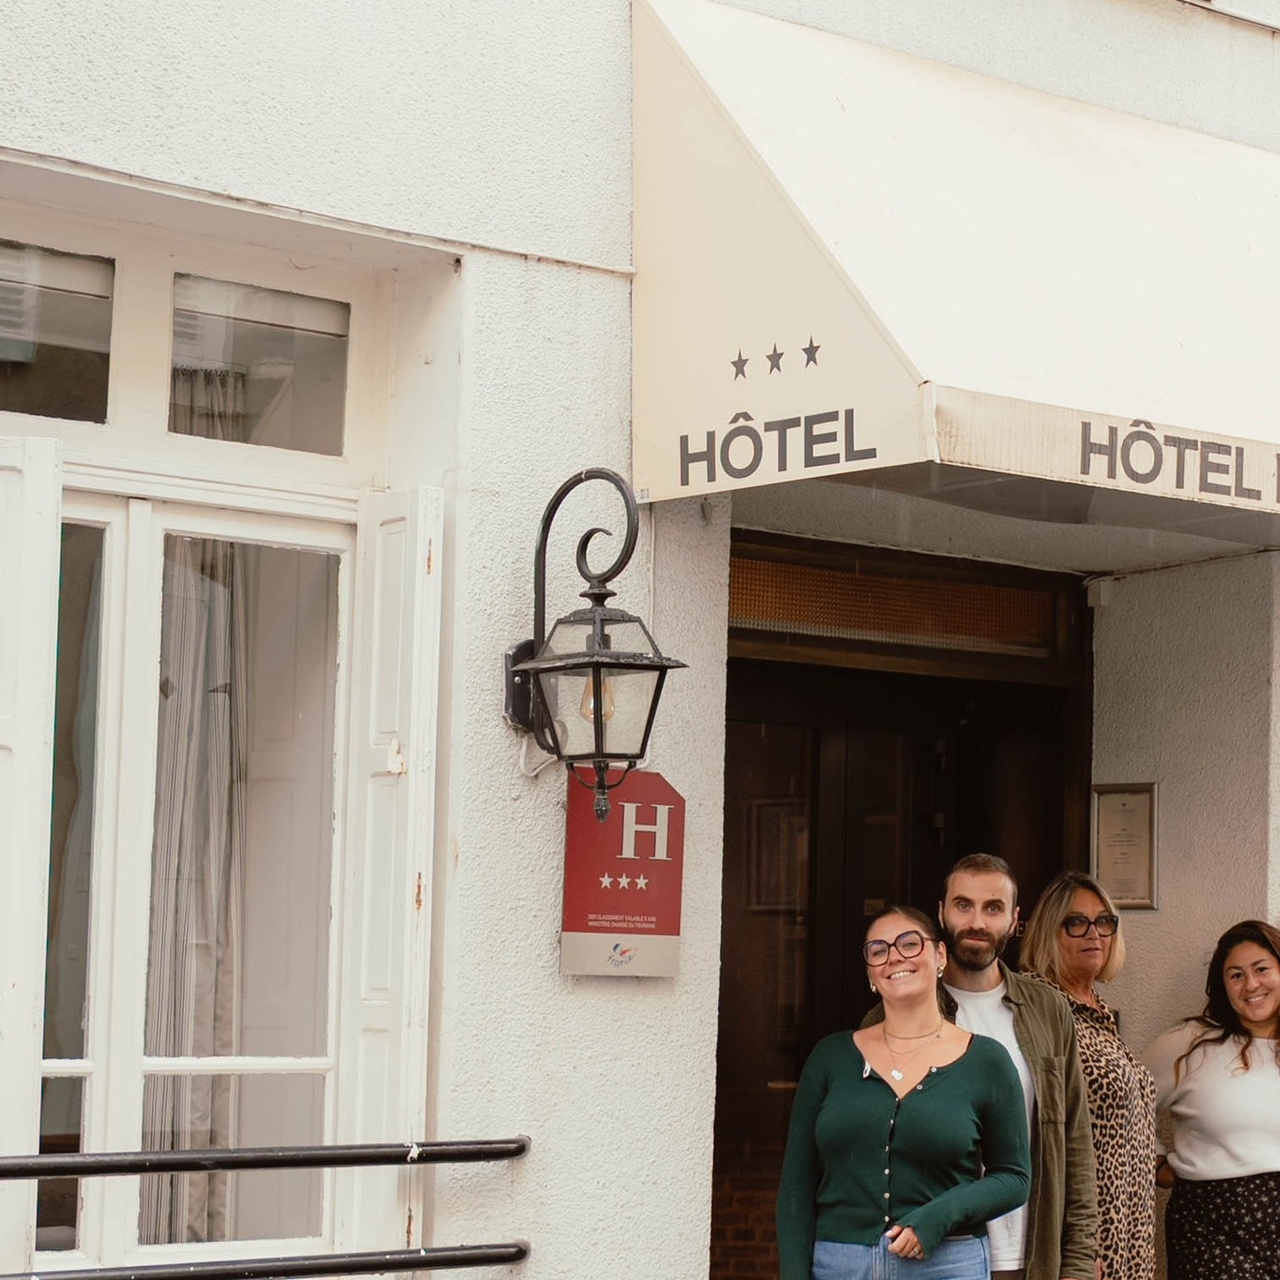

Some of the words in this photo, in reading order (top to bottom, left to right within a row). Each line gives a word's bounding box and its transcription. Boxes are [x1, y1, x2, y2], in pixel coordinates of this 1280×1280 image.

[680, 408, 877, 487] HÔTEL
[1080, 419, 1262, 501] HÔTEL
[616, 801, 675, 861] H
